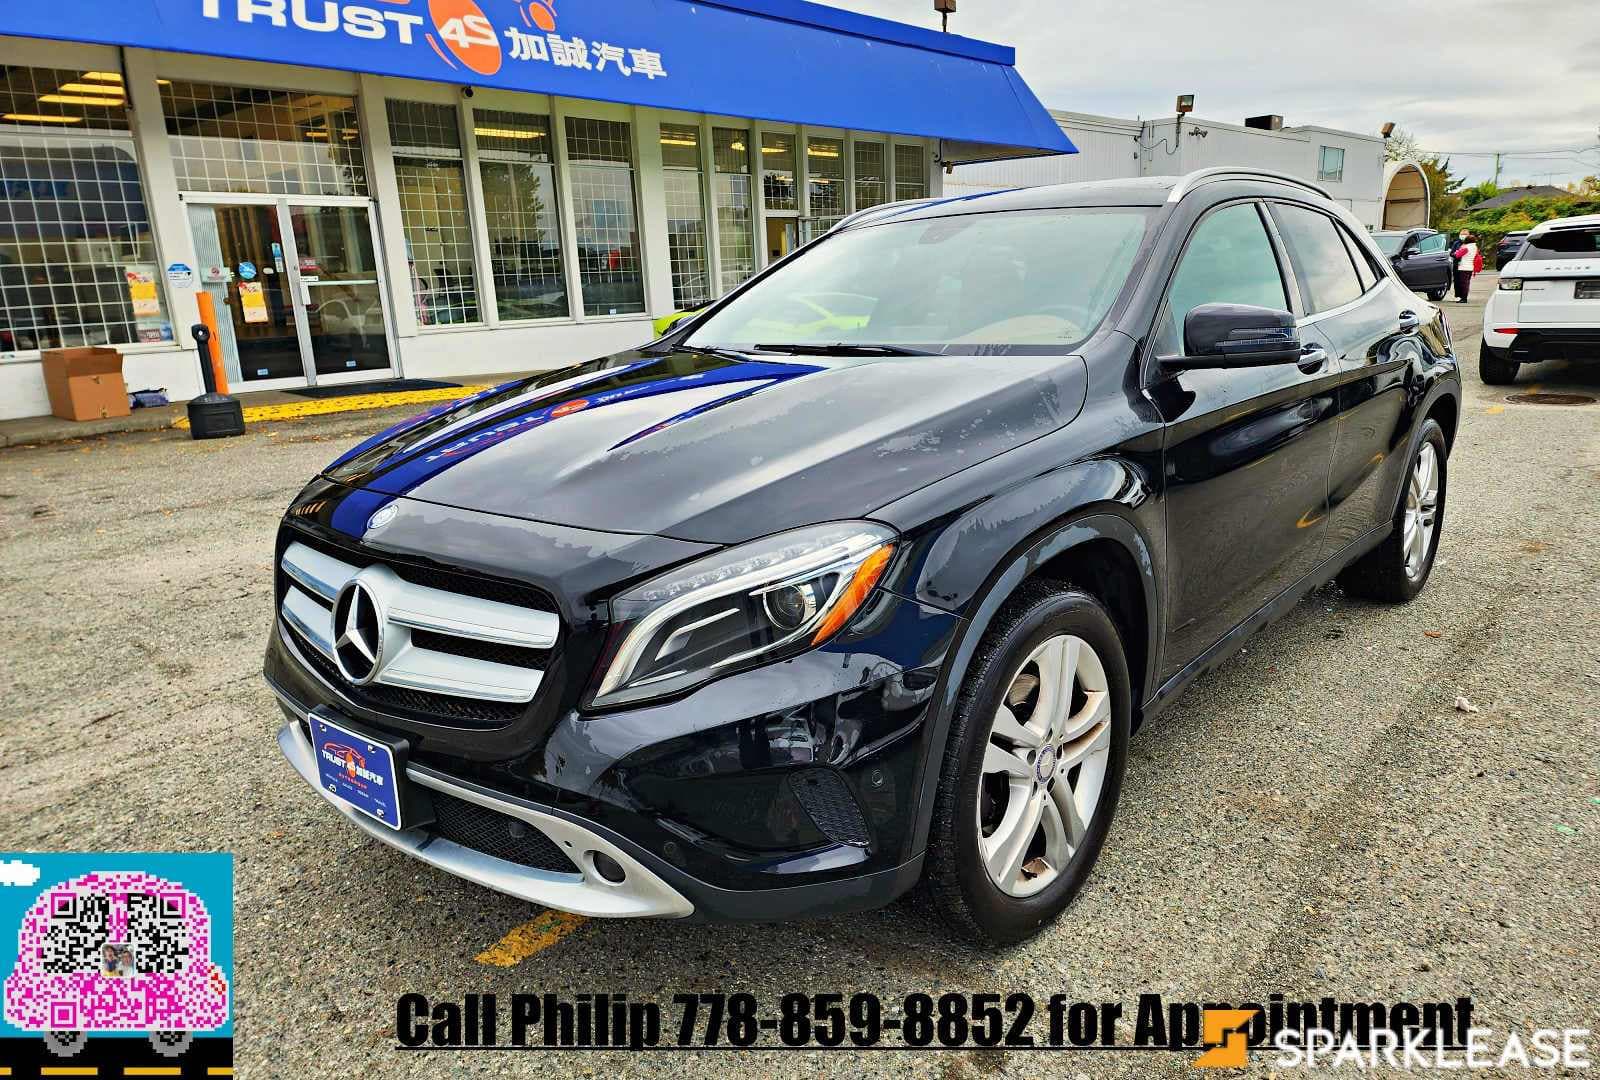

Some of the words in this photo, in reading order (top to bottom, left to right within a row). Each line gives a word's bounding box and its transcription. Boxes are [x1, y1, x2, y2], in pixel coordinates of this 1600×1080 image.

[439, 14, 499, 48] 4S
[504, 26, 667, 80] 加誠汽車
